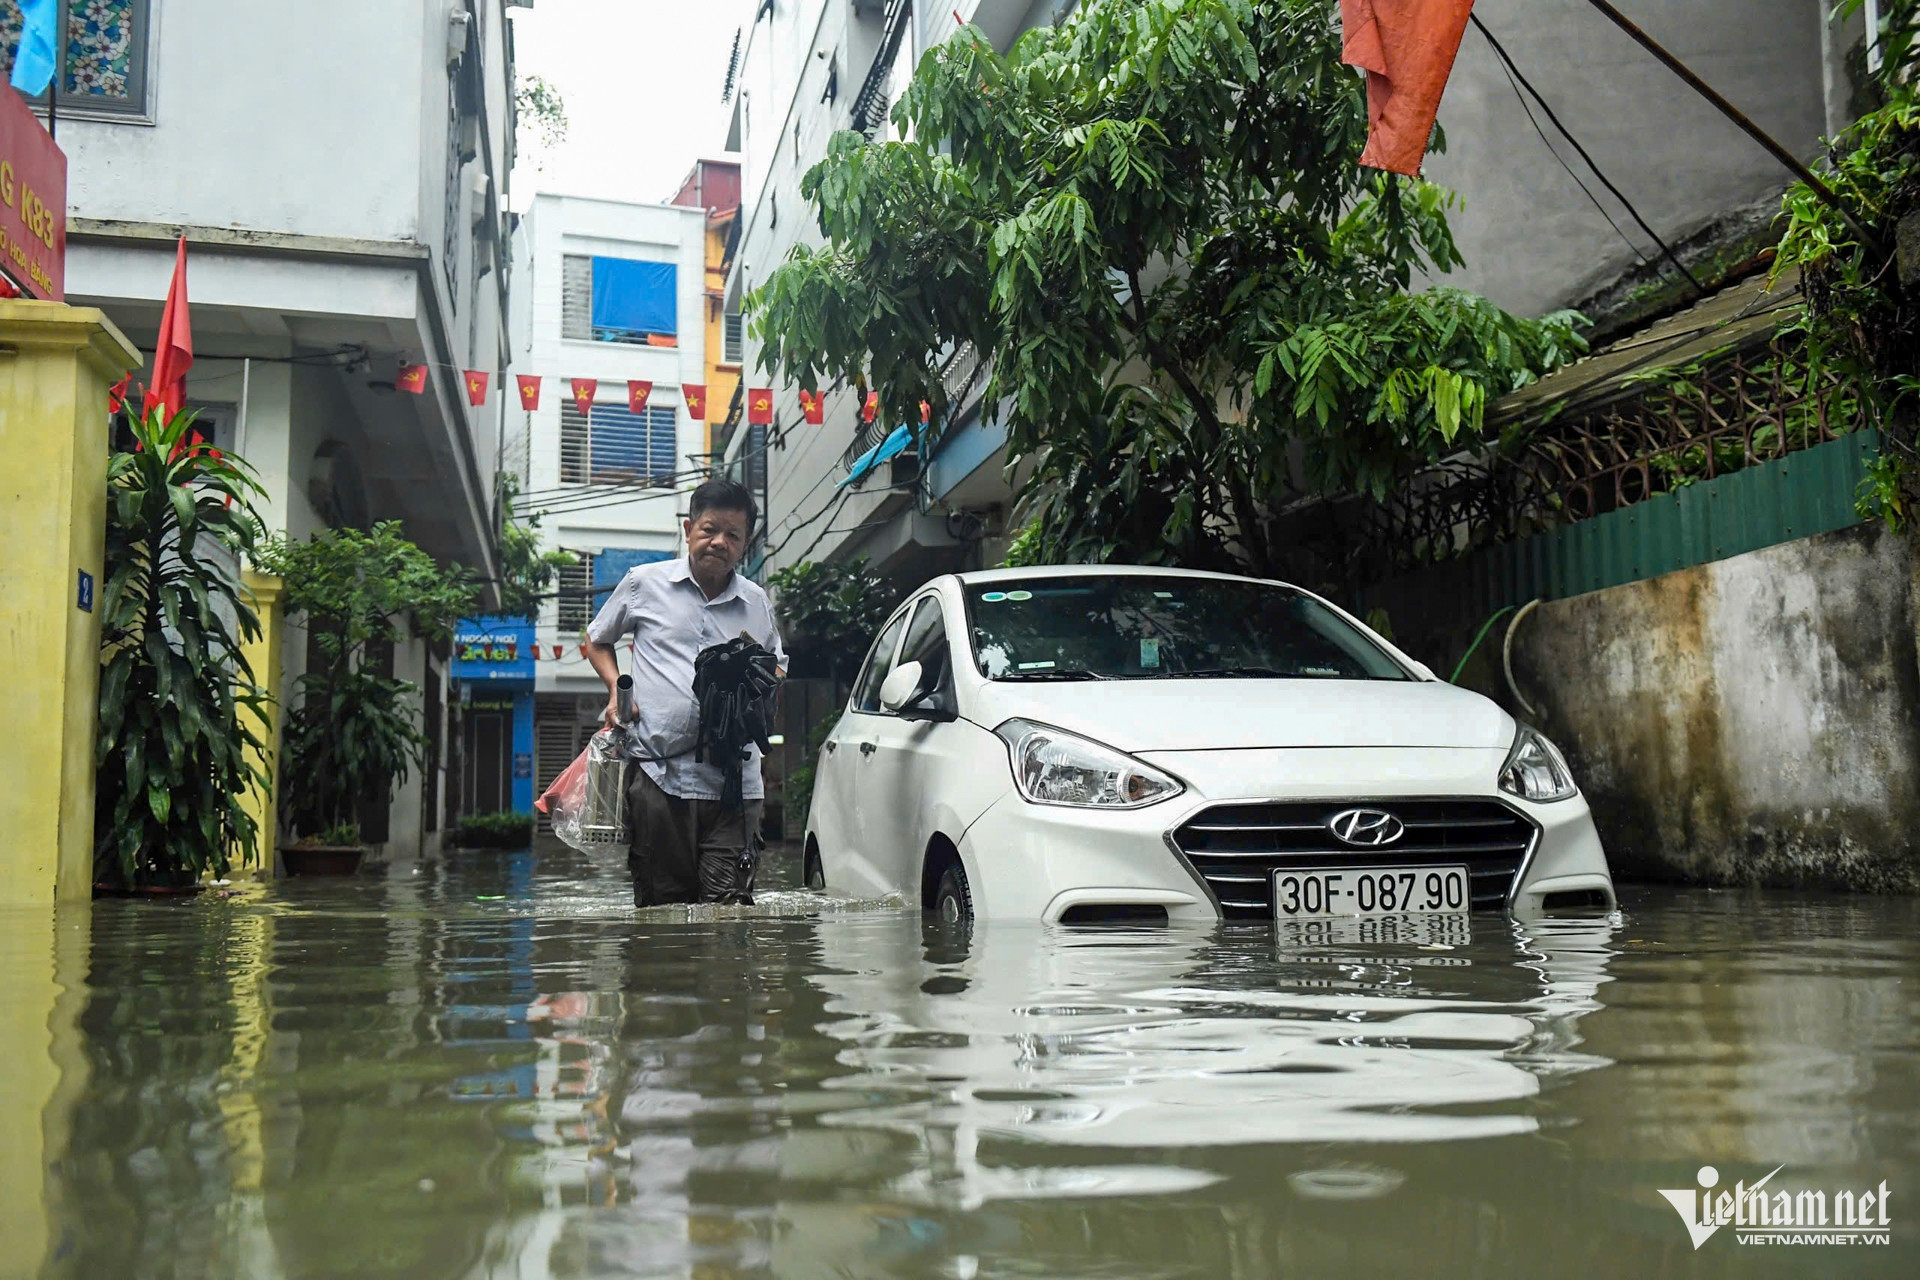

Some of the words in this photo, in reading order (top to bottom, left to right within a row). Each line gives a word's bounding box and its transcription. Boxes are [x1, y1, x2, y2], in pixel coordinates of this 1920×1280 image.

[21, 182, 54, 250] K83
[9, 239, 27, 272] HOA
[83, 577, 89, 604] 2
[1281, 872, 1464, 914] 30F-087.90
